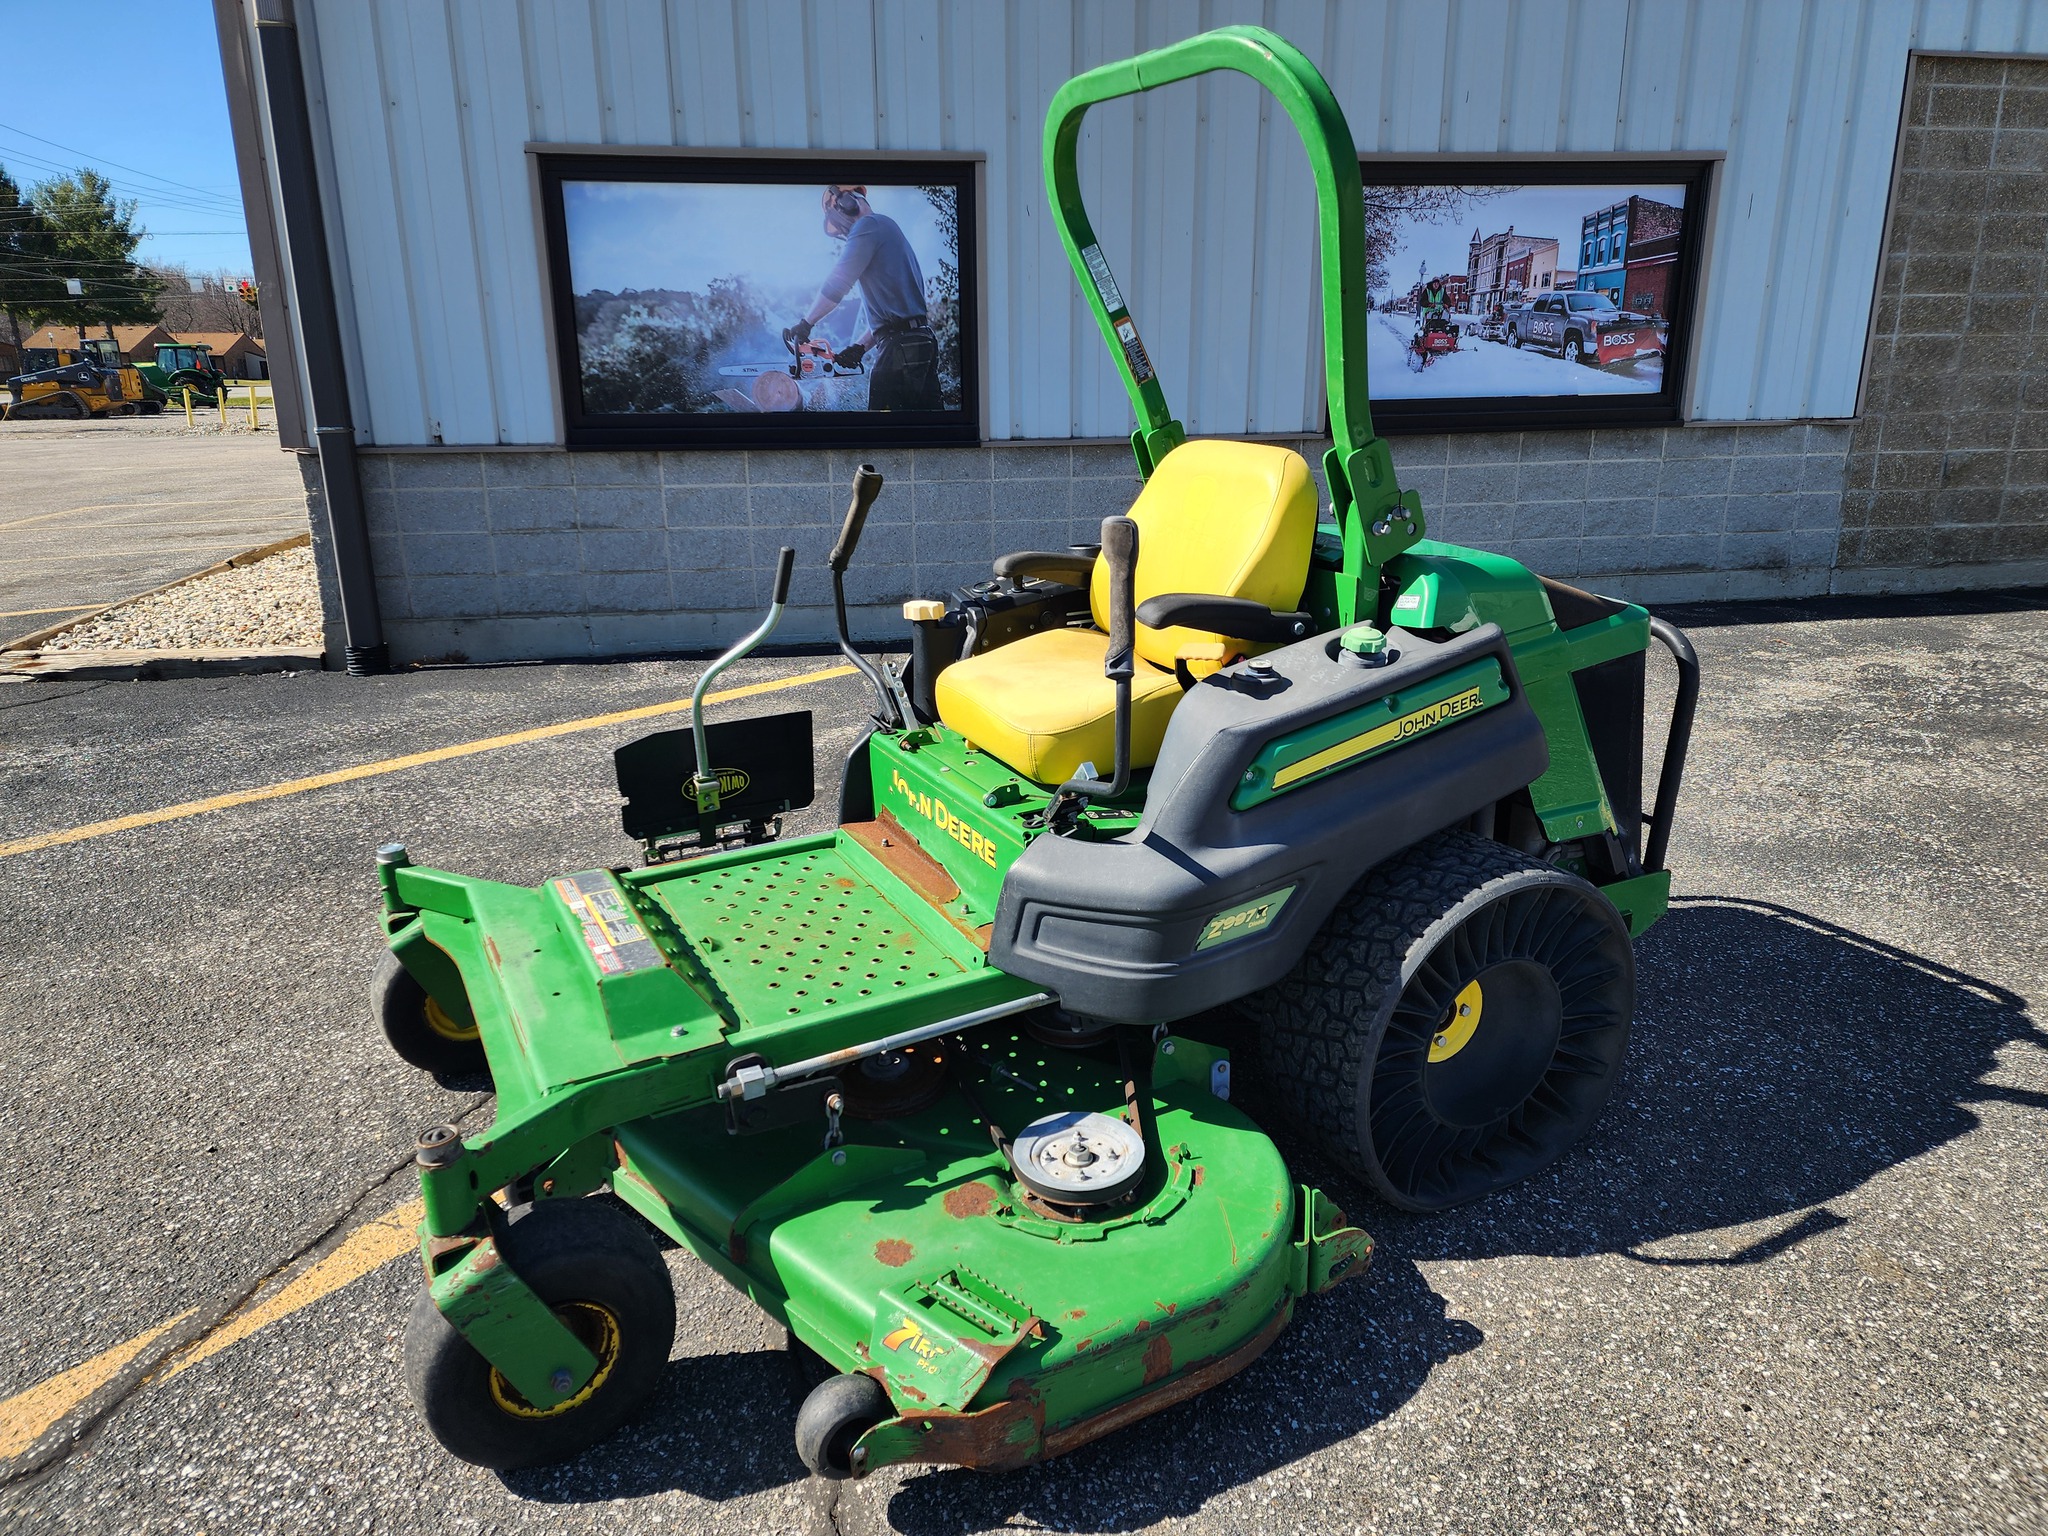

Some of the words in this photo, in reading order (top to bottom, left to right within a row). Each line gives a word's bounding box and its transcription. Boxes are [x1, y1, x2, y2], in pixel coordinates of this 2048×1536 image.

[1533, 320, 1554, 336] BOSS
[1603, 333, 1635, 346] BOSS
[1394, 710, 1436, 739] JOHN
[1440, 694, 1483, 719] DEER
[935, 798, 997, 870] DEERE
